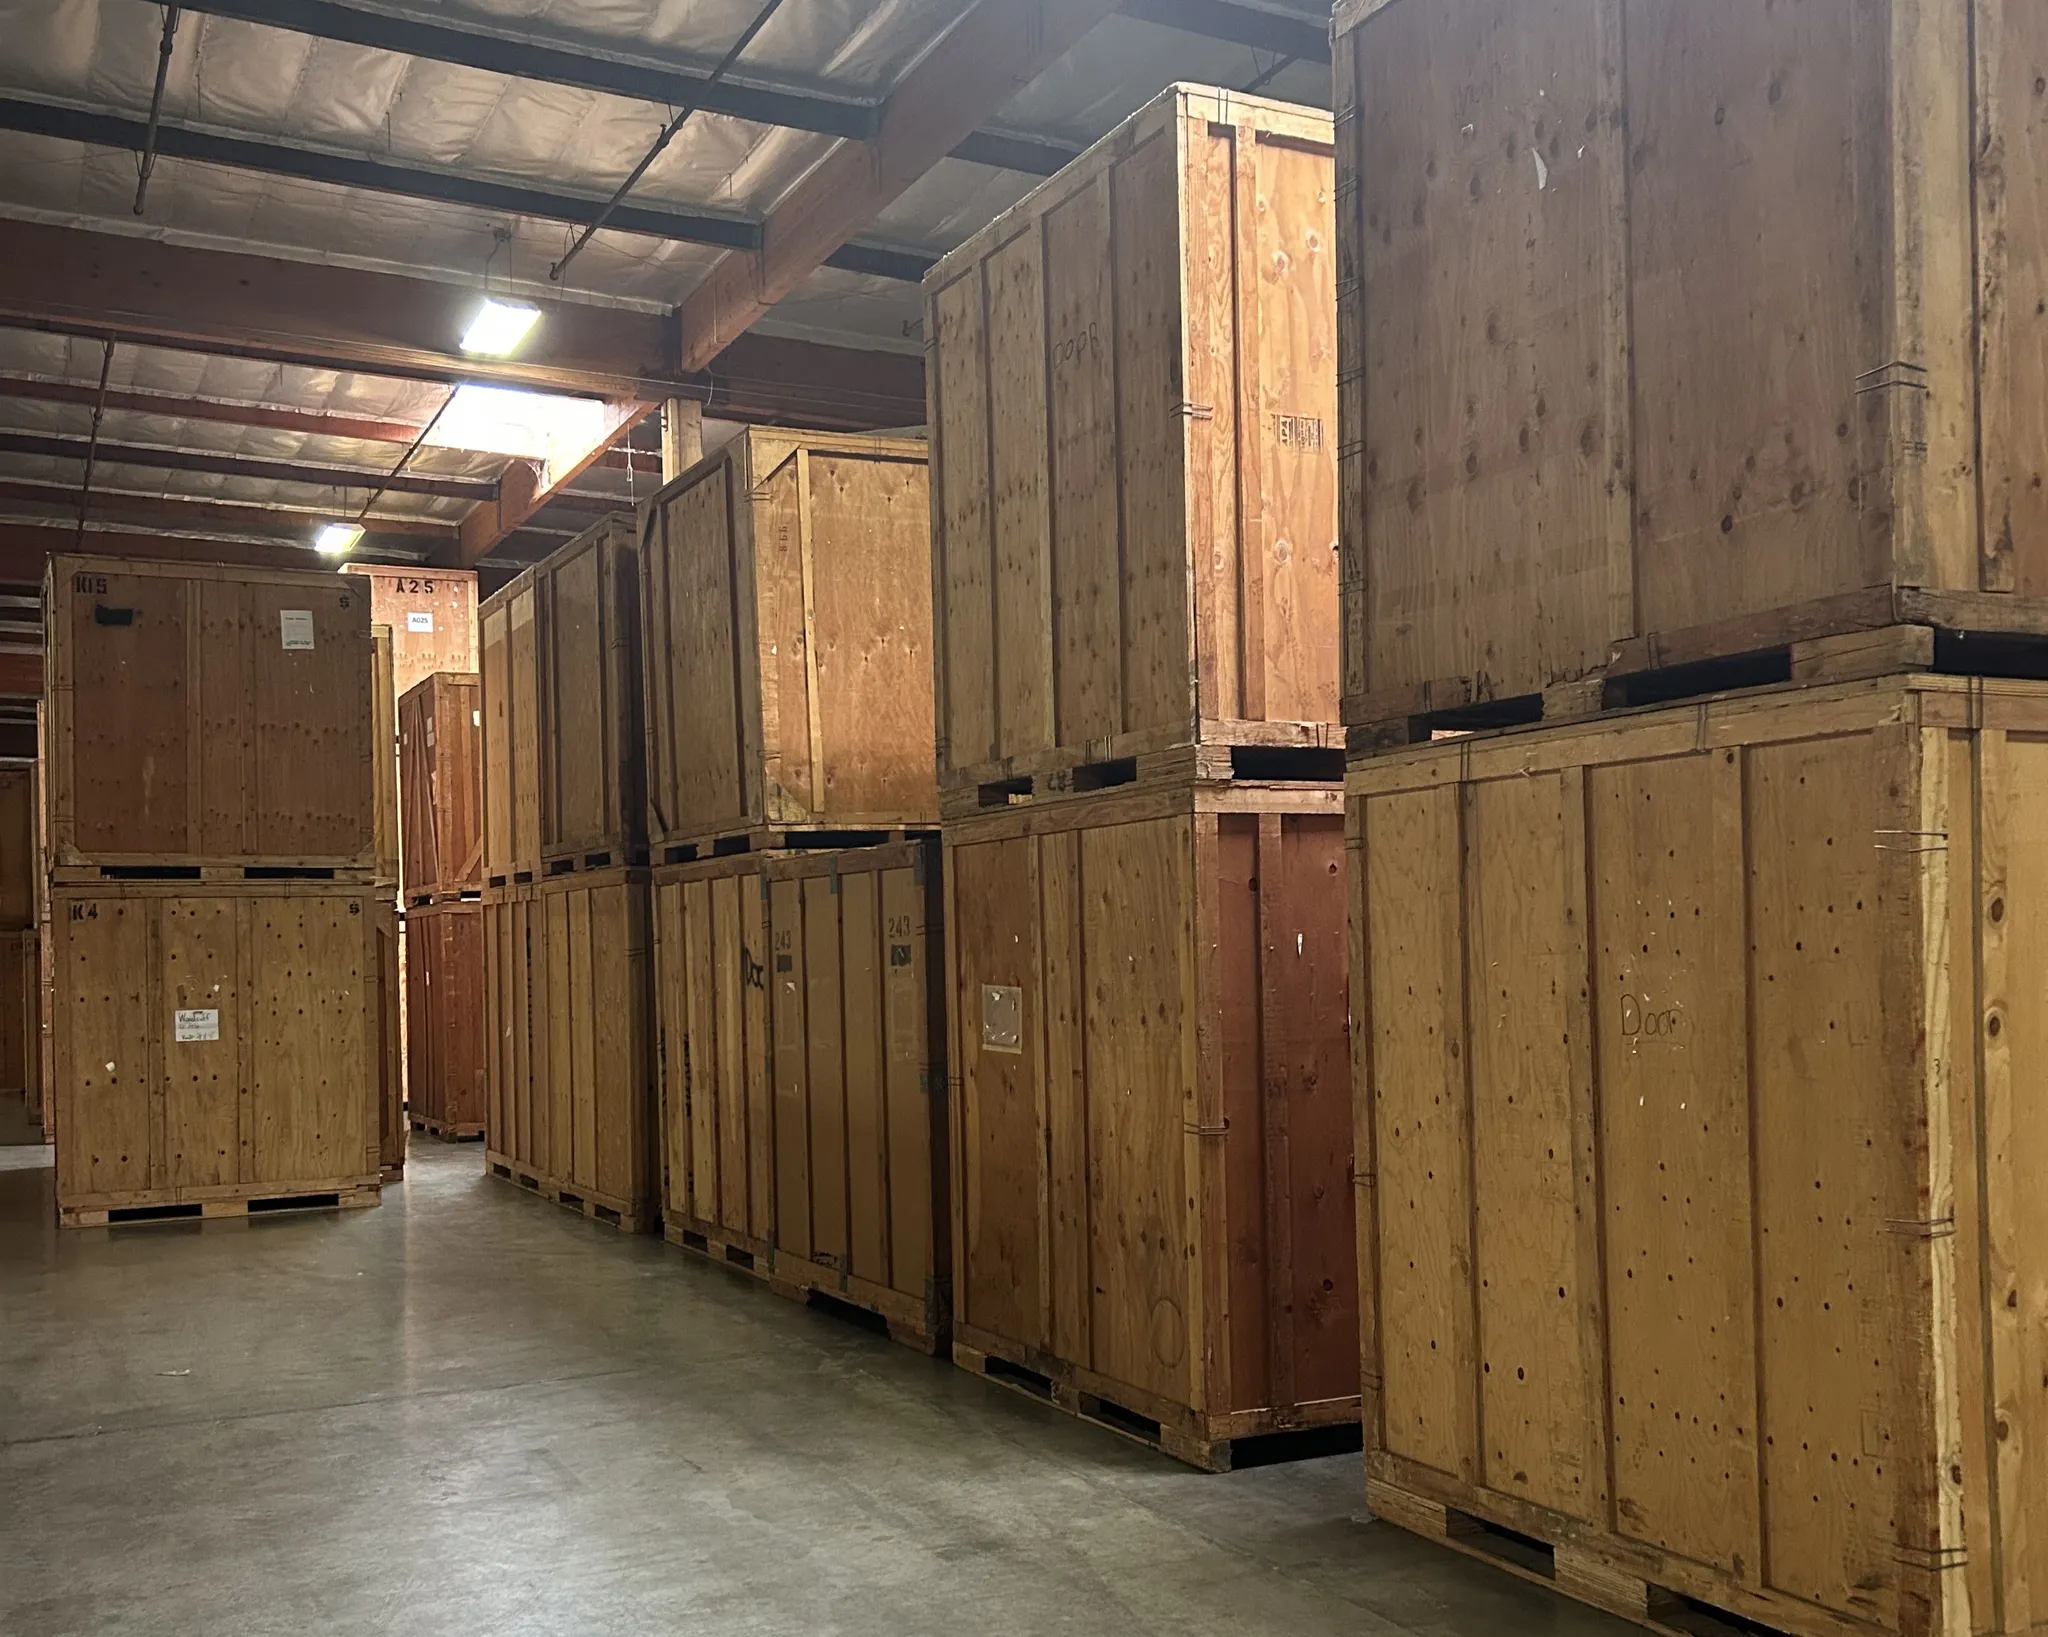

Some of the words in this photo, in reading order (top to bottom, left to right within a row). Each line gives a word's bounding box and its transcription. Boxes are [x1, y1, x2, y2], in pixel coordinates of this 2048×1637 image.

[76, 575, 107, 594] K15
[396, 578, 434, 593] A25
[73, 903, 98, 920] K4
[888, 915, 911, 938] 243
[775, 930, 791, 950] 243
[1620, 994, 1684, 1036] Door
